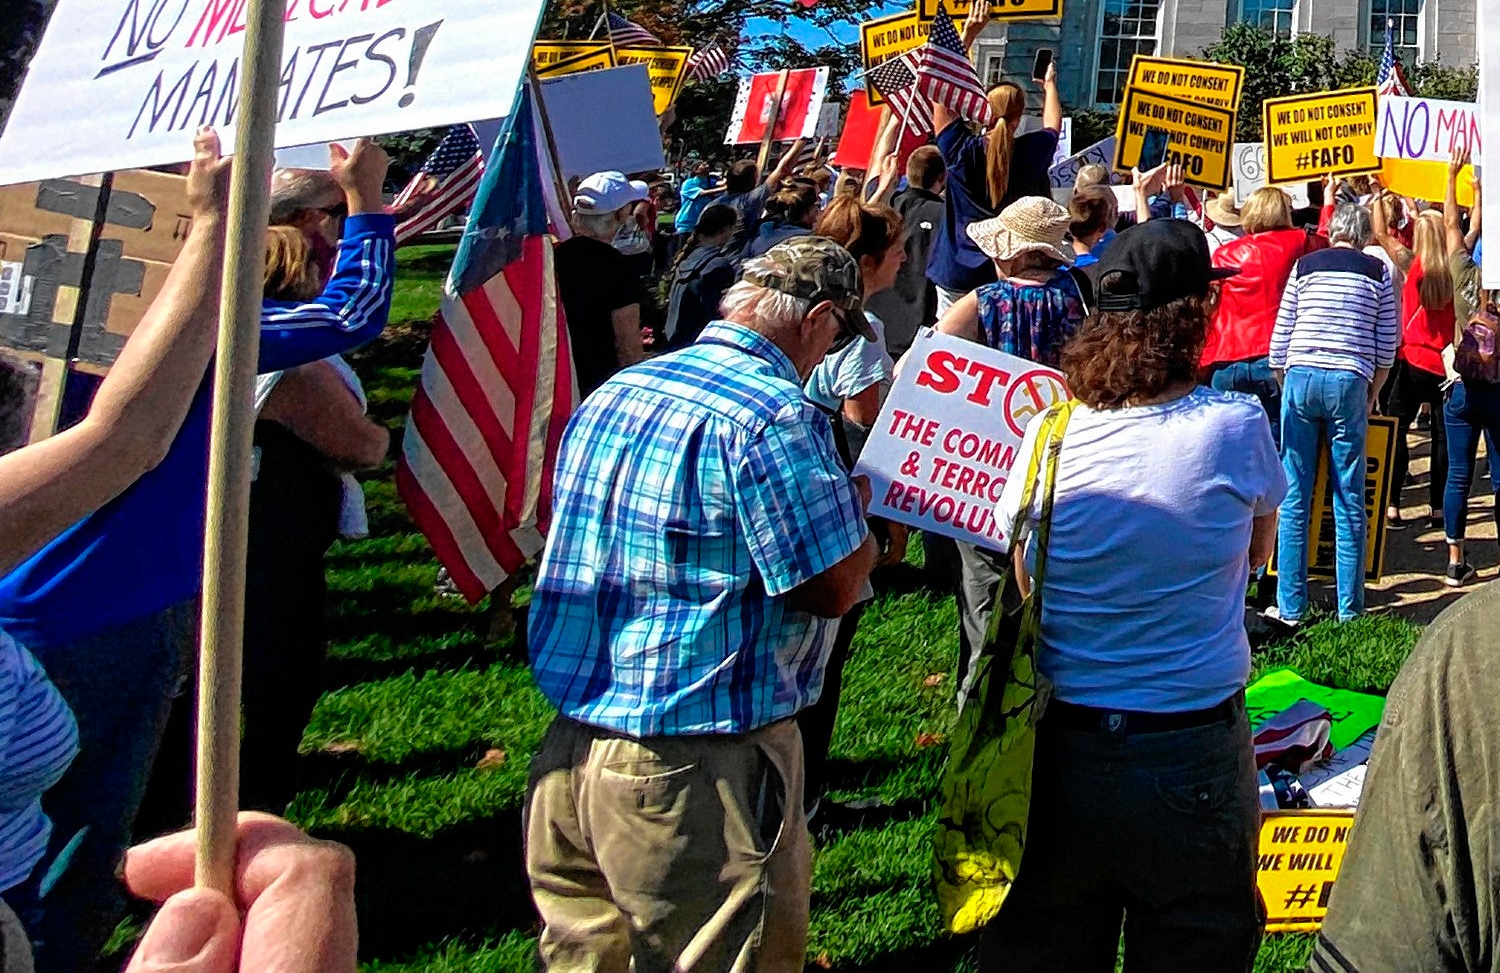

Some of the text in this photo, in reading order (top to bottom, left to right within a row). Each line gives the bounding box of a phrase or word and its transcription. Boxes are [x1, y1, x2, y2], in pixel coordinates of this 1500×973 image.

[873, 34, 886, 49] WE
[887, 32, 898, 44] DO
[900, 28, 916, 42] NOT
[127, 19, 444, 139] MANATES!
[1142, 70, 1229, 91] WE DO NOT CONSENT
[1137, 100, 1150, 117] WE
[1152, 103, 1165, 120] DO
[1167, 108, 1184, 125] NOT
[1185, 112, 1223, 133] CONSENT
[1277, 102, 1367, 126] WE DO NOT CONSENT
[1129, 120, 1144, 137] WE
[1190, 134, 1226, 154] COMPLY
[1273, 122, 1373, 147] WE WILL NOT COMPLY
[1381, 101, 1430, 158] NO
[1295, 144, 1354, 170] #FAFO
[889, 410, 940, 447] THE
[900, 451, 920, 478] &
[1272, 826, 1301, 843] WE
[1303, 826, 1330, 843] DO
[1258, 853, 1334, 871] WE WILL
